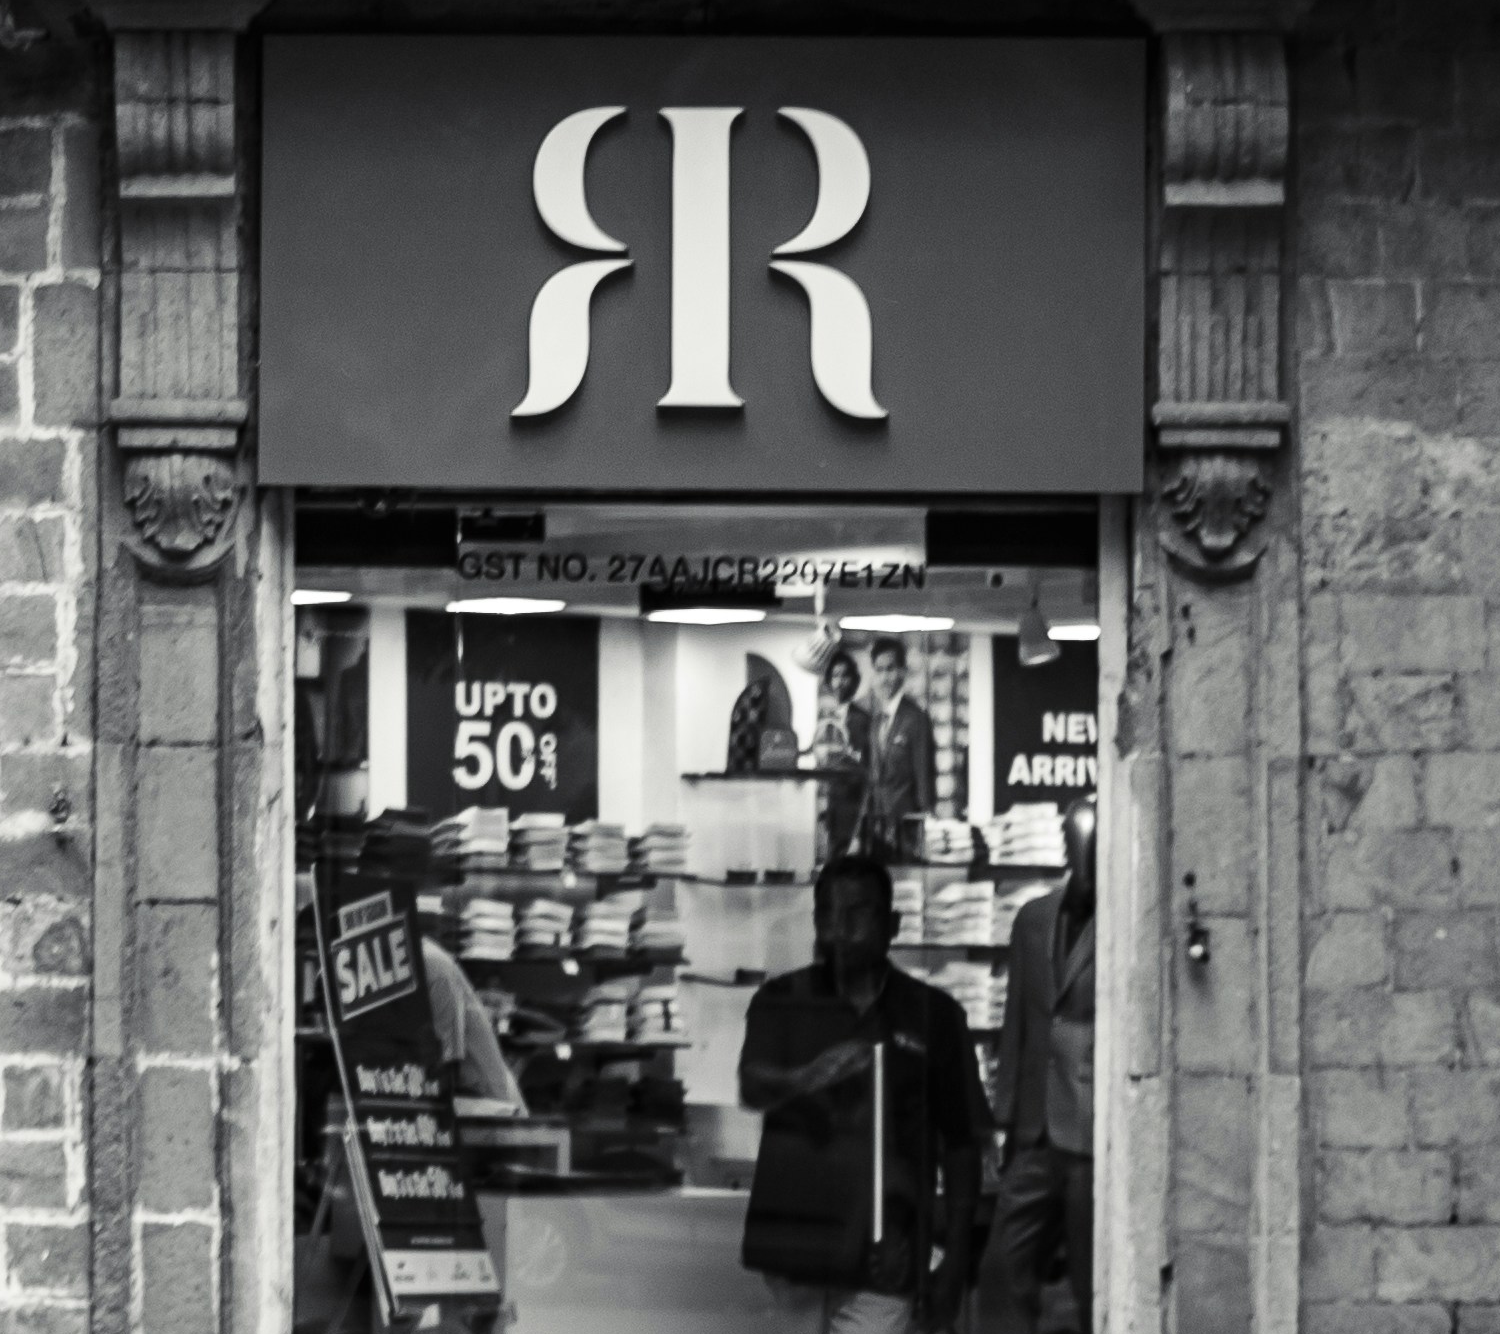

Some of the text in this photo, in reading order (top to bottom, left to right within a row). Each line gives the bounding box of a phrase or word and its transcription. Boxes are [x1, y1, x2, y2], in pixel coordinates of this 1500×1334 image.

[458, 550, 526, 581] GST
[537, 551, 599, 583] NO.
[455, 680, 557, 719] UPTO
[335, 927, 411, 1005] SALE
